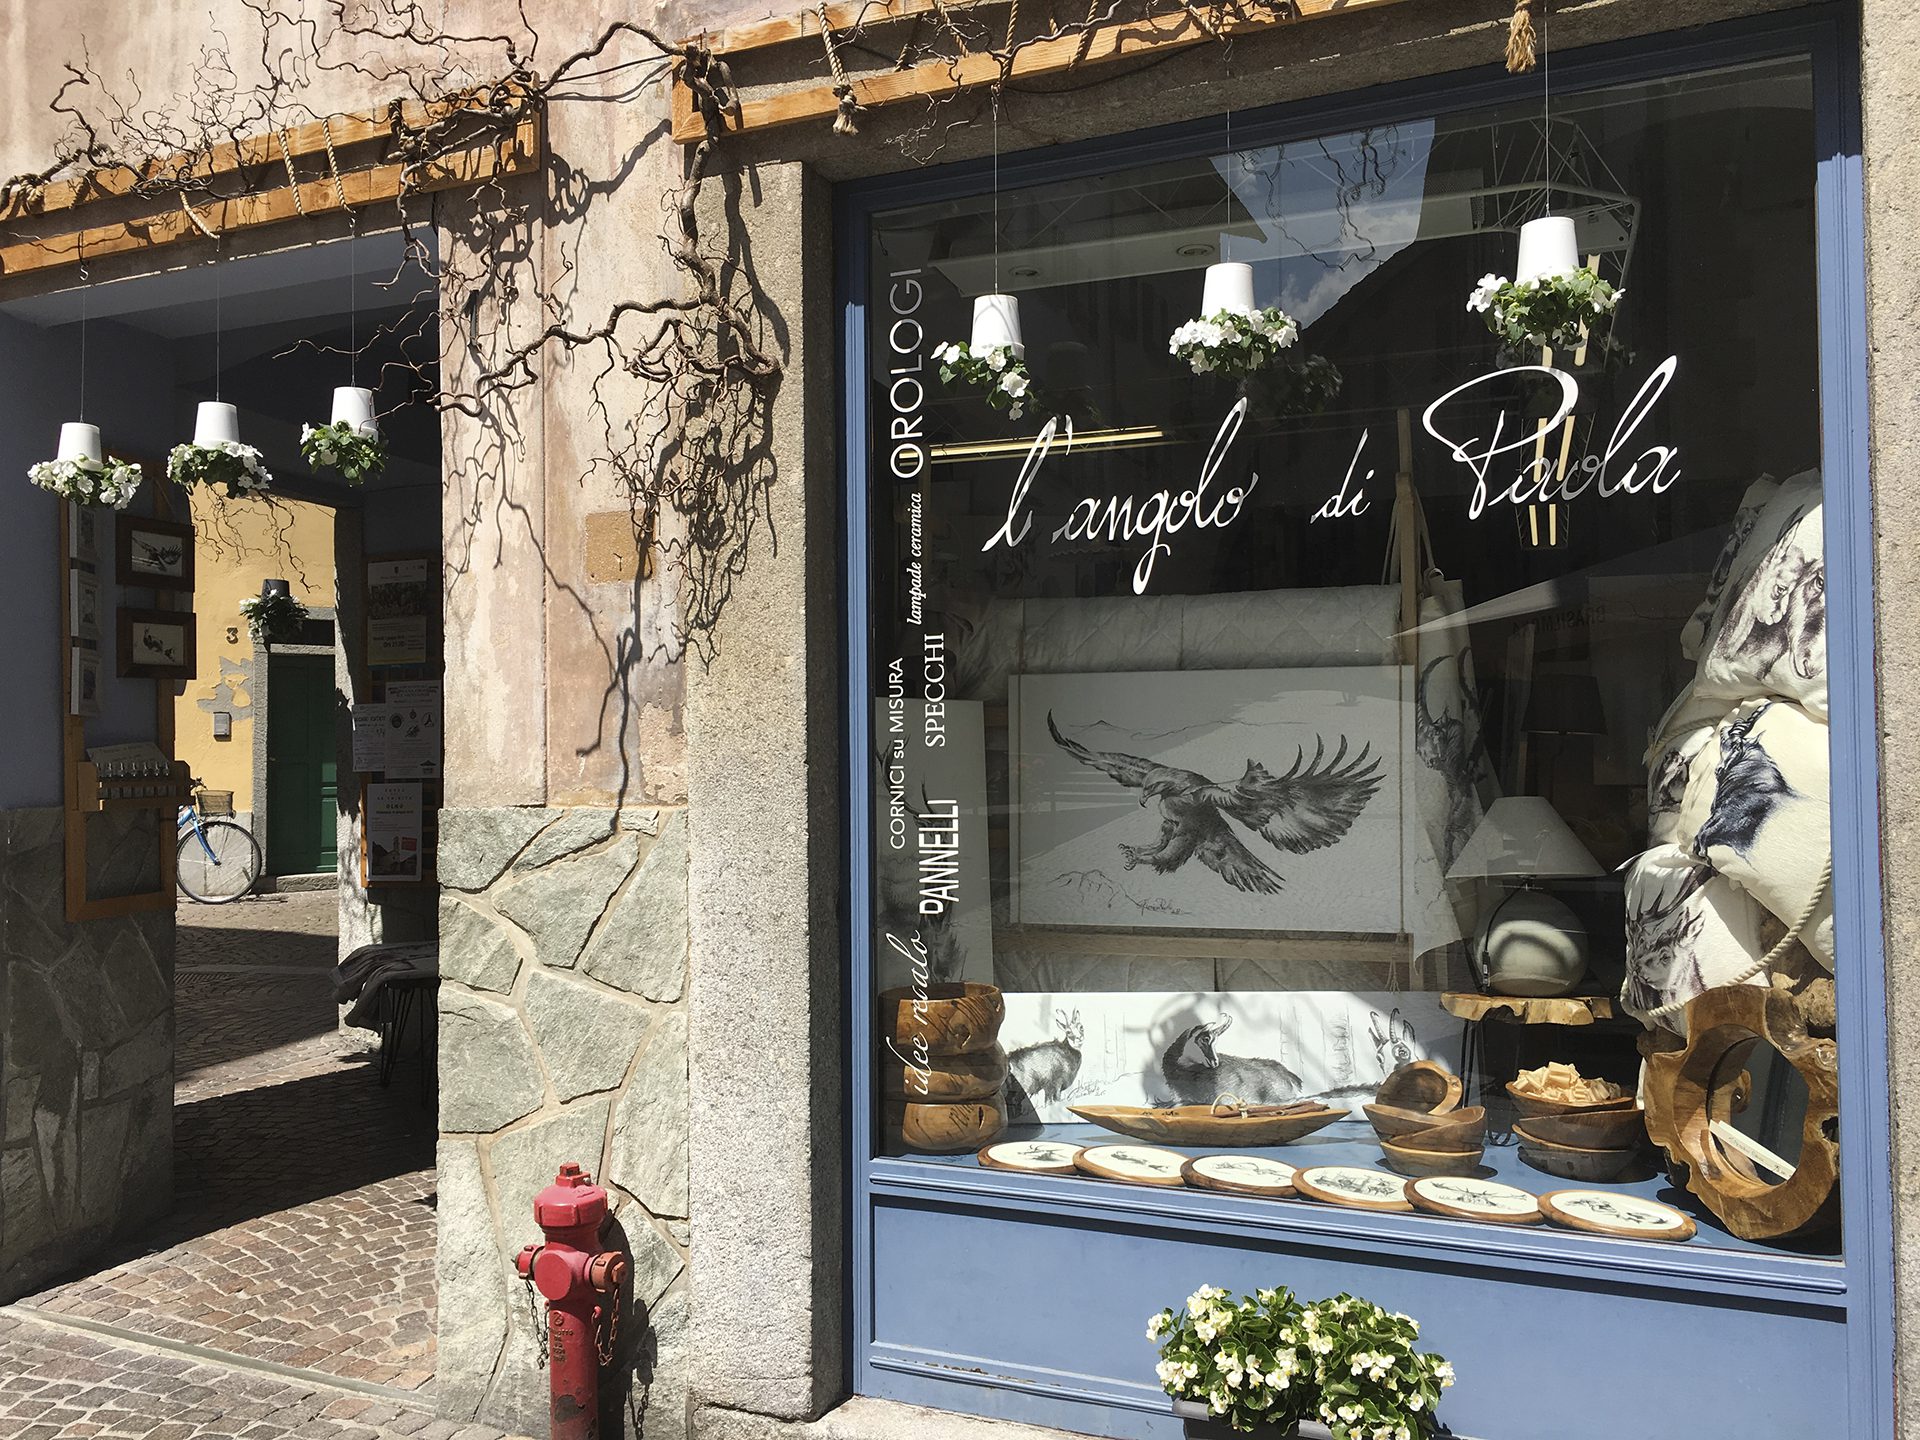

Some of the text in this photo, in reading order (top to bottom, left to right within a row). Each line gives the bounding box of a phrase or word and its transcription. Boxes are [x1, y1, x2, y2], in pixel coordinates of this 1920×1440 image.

[889, 268, 924, 479] OROLOGI
[1310, 428, 1375, 524] di
[1422, 355, 1682, 520] Paola
[906, 492, 927, 625] lampade ceramica
[226, 627, 239, 645] 3
[924, 633, 946, 747] SPECCHI
[889, 657, 906, 850] CORNICI su MISURA
[885, 1032, 932, 1096] idee
